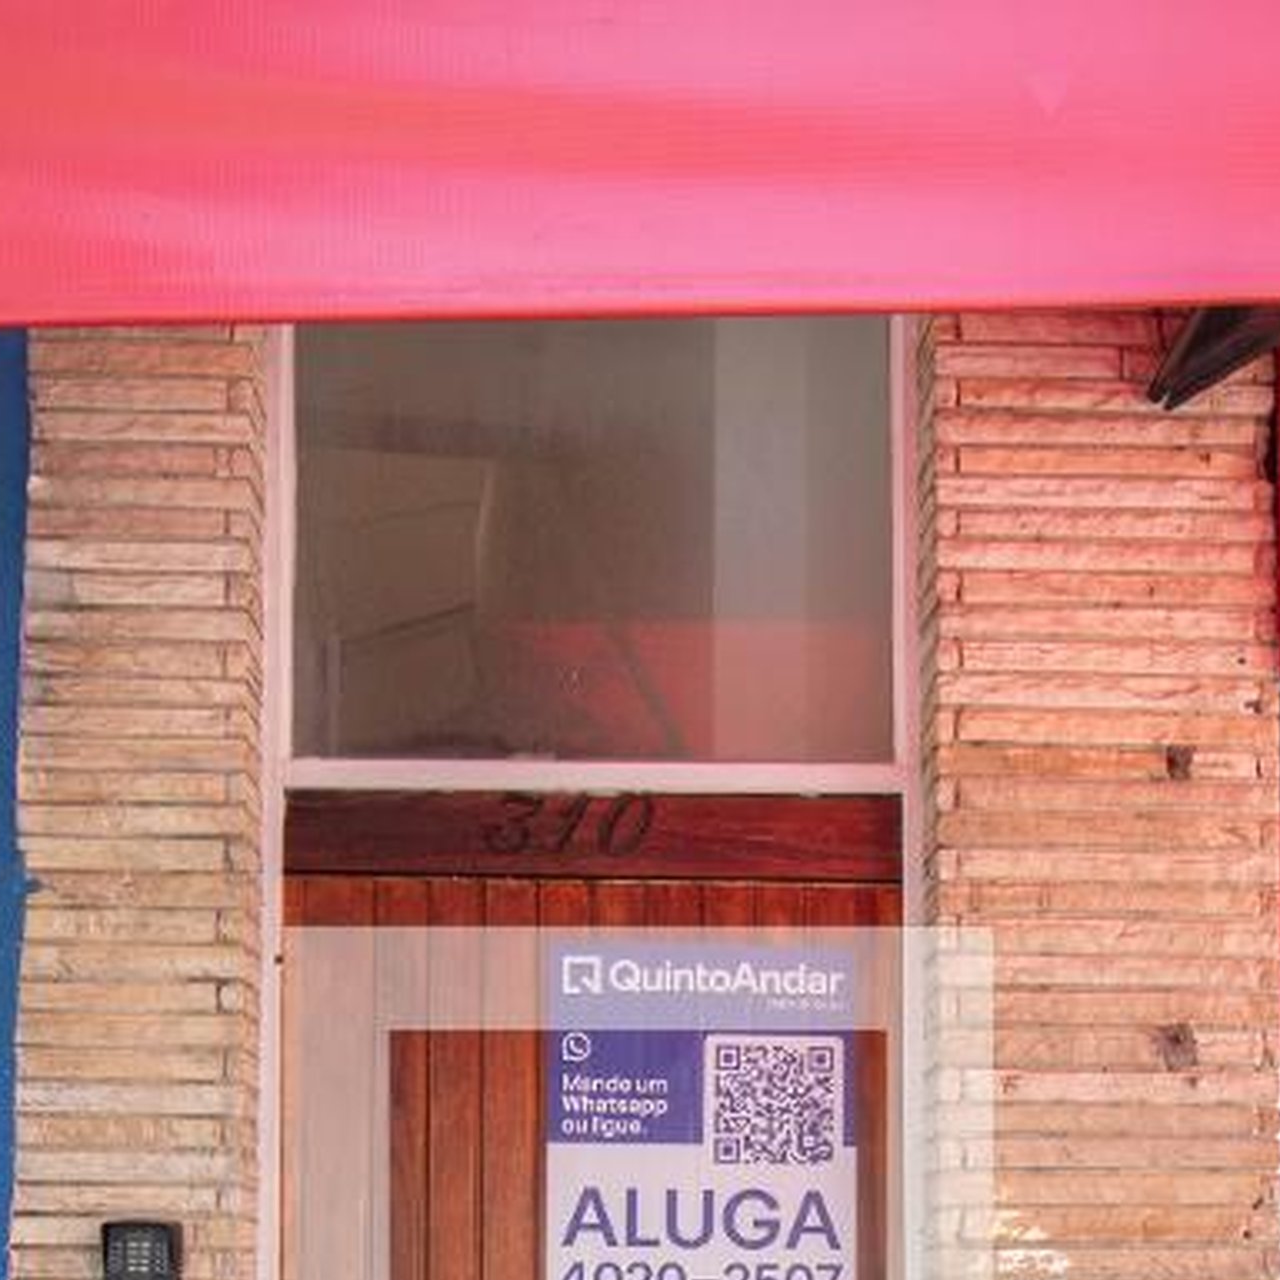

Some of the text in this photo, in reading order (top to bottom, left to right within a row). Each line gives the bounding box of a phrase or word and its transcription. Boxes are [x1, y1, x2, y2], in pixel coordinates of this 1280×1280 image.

[609, 959, 845, 997] QuintoAndar
[562, 1073, 669, 1093] Mande um
[561, 1117, 588, 1134] ou
[562, 1186, 841, 1251] ALUGA
